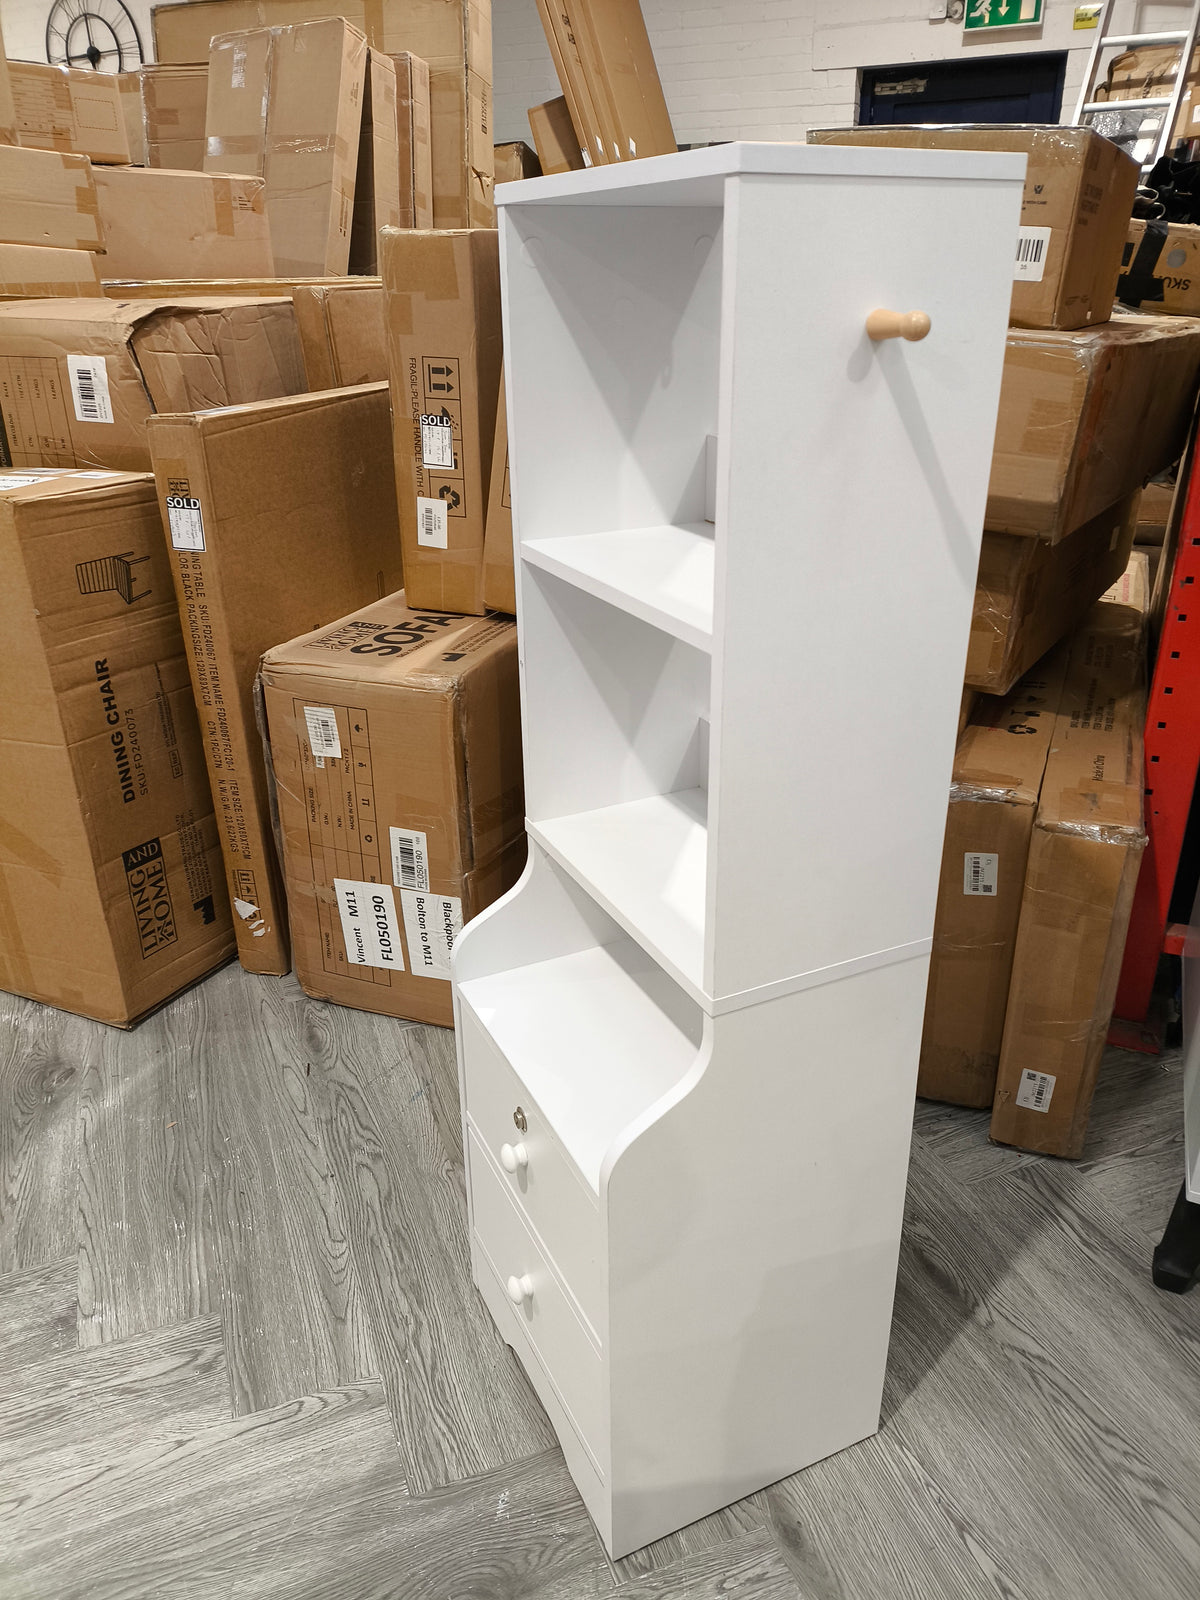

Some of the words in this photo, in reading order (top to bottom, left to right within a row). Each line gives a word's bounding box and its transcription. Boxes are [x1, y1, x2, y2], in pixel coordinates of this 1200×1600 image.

[421, 414, 451, 427] SOLD
[414, 427, 422, 462] HANDLE
[416, 466, 424, 487] WITH
[166, 497, 200, 509] SOLD
[191, 552, 201, 570] NING
[194, 571, 206, 598] TABLE
[199, 605, 216, 660] SKU:FD240067
[350, 615, 466, 657] SOFA
[209, 664, 220, 682] ITEM
[95, 658, 120, 726] CHAIR
[110, 730, 136, 804] DINING
[124, 708, 149, 796] SKU:FD240073
[127, 842, 158, 867] AND
[416, 849, 424, 890] FL050190
[130, 870, 158, 952] LIVING
[146, 861, 174, 944] HOME
[345, 890, 359, 918] M11
[416, 897, 426, 929] Bolton
[353, 927, 366, 963] Vincent
[372, 895, 394, 962] FL050190
[421, 932, 428, 943] to
[423, 944, 433, 966] M11
